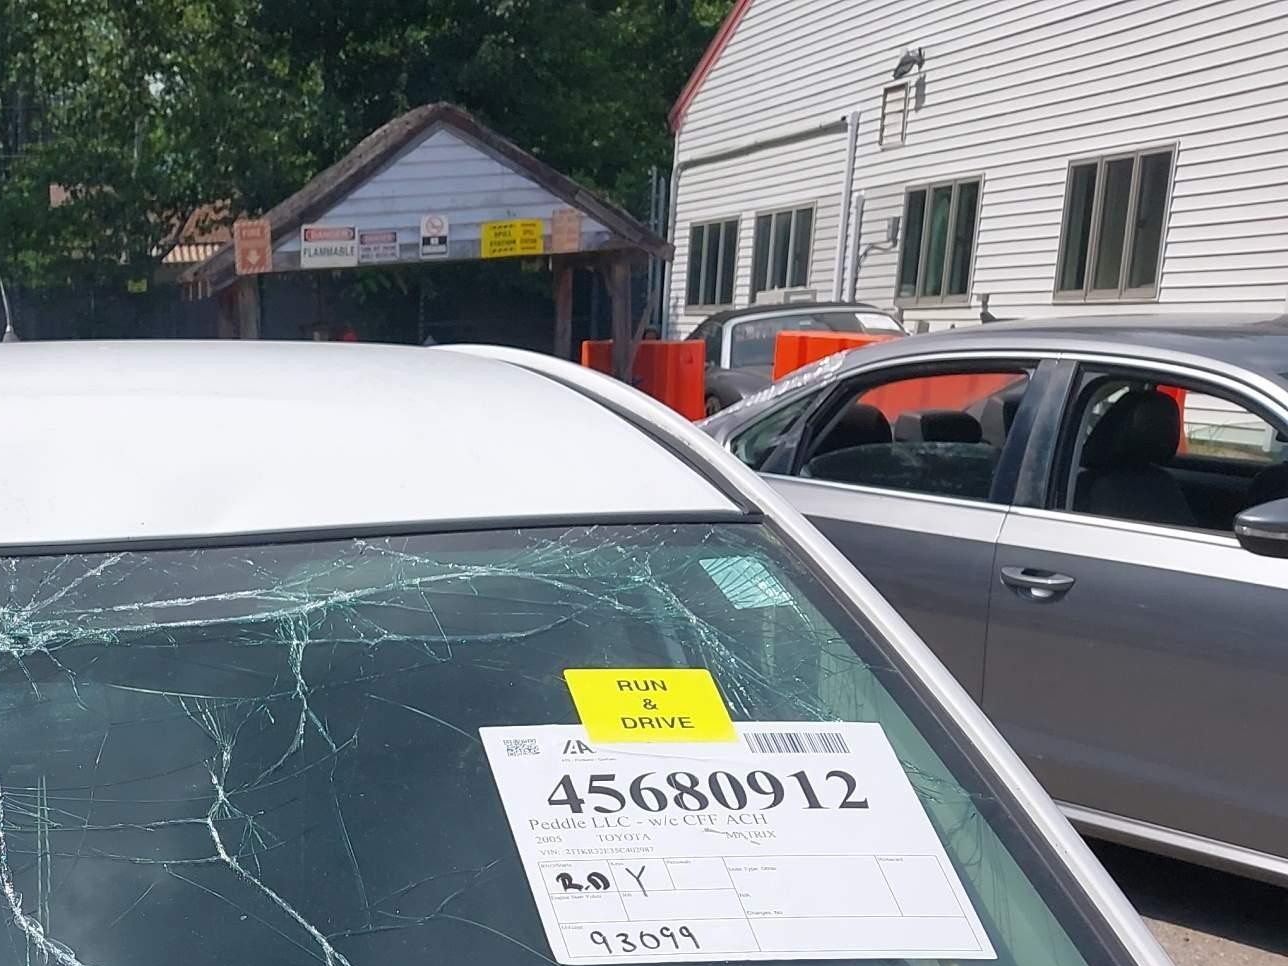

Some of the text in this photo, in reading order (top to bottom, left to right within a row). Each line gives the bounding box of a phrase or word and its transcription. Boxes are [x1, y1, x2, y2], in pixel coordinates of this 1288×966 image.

[303, 246, 355, 258] FLAMMABLE
[617, 679, 668, 691] RUN
[643, 698, 658, 710] &
[621, 716, 695, 729] DRIVE
[547, 769, 869, 814] 45680912
[528, 816, 587, 831] Peddle
[591, 815, 632, 829] LLC
[726, 813, 769, 825] ACH
[535, 830, 777, 844] 2005 TOYOTA MATRIX
[540, 849, 561, 857] VIN:
[625, 865, 649, 897] Y
[590, 925, 701, 954] 93099
